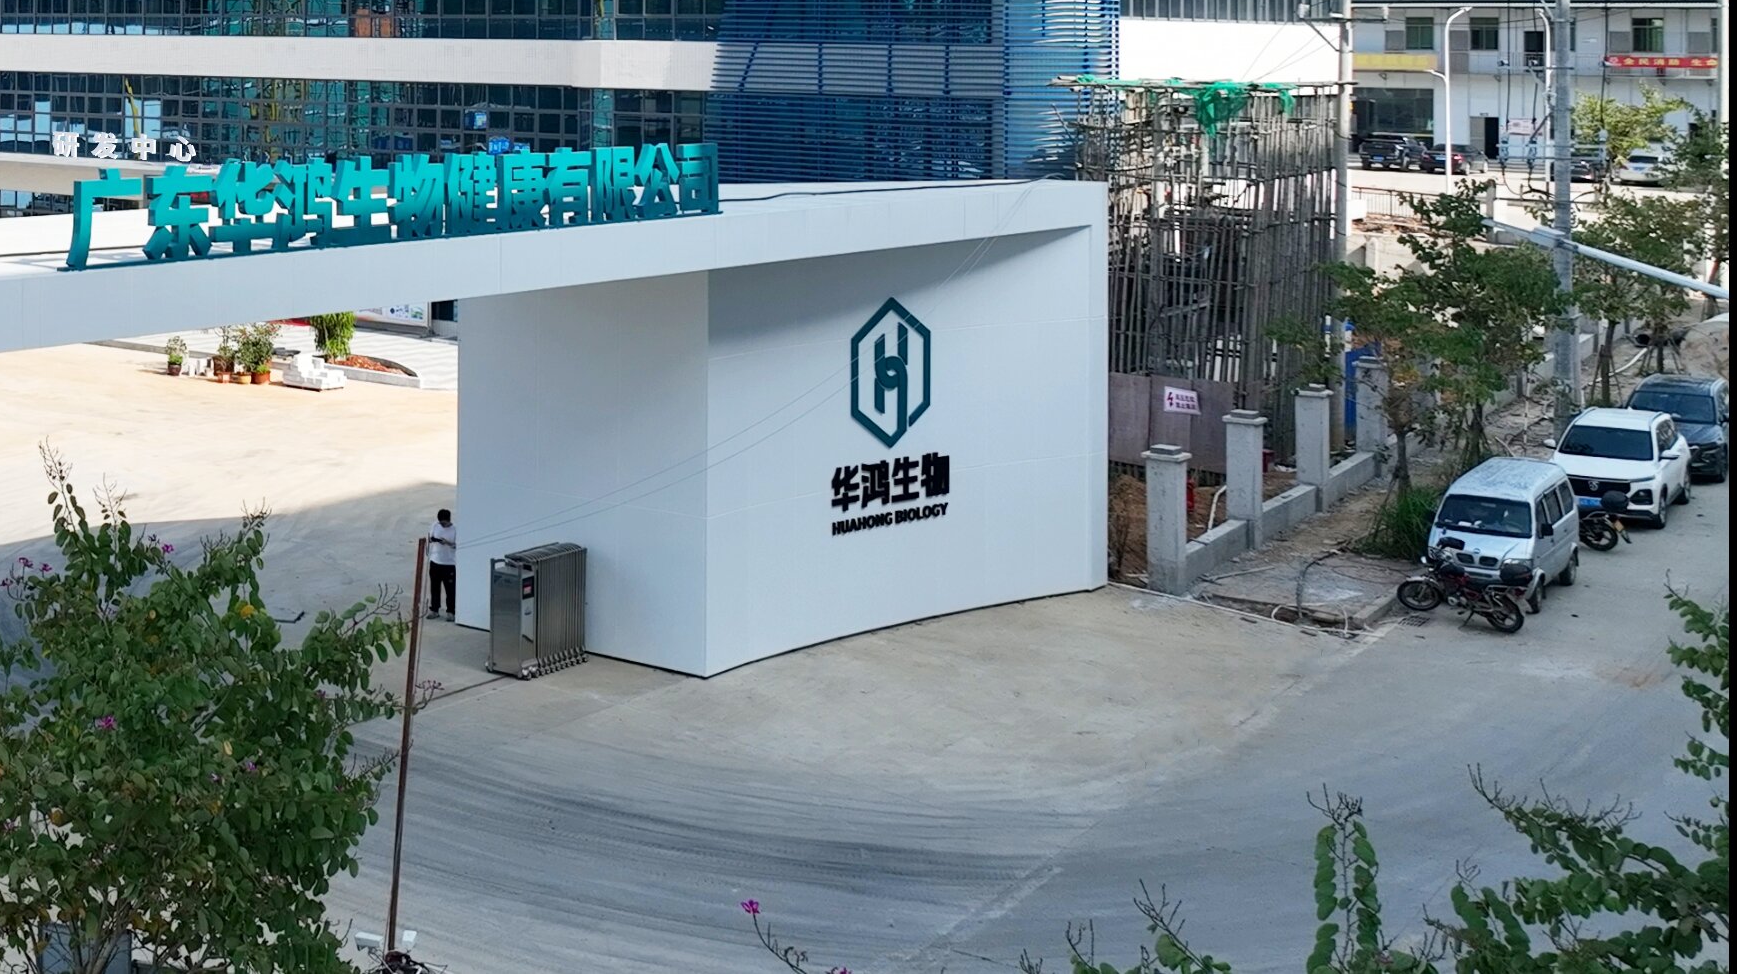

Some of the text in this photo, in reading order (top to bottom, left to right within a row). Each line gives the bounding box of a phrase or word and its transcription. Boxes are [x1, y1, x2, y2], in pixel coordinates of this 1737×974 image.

[52, 131, 197, 162] 研发中心
[65, 142, 719, 270] 广东华鸿生物健康有限公司
[831, 452, 950, 512] 华鸿生物
[832, 502, 949, 536] HUAHONG BIOLOGY
